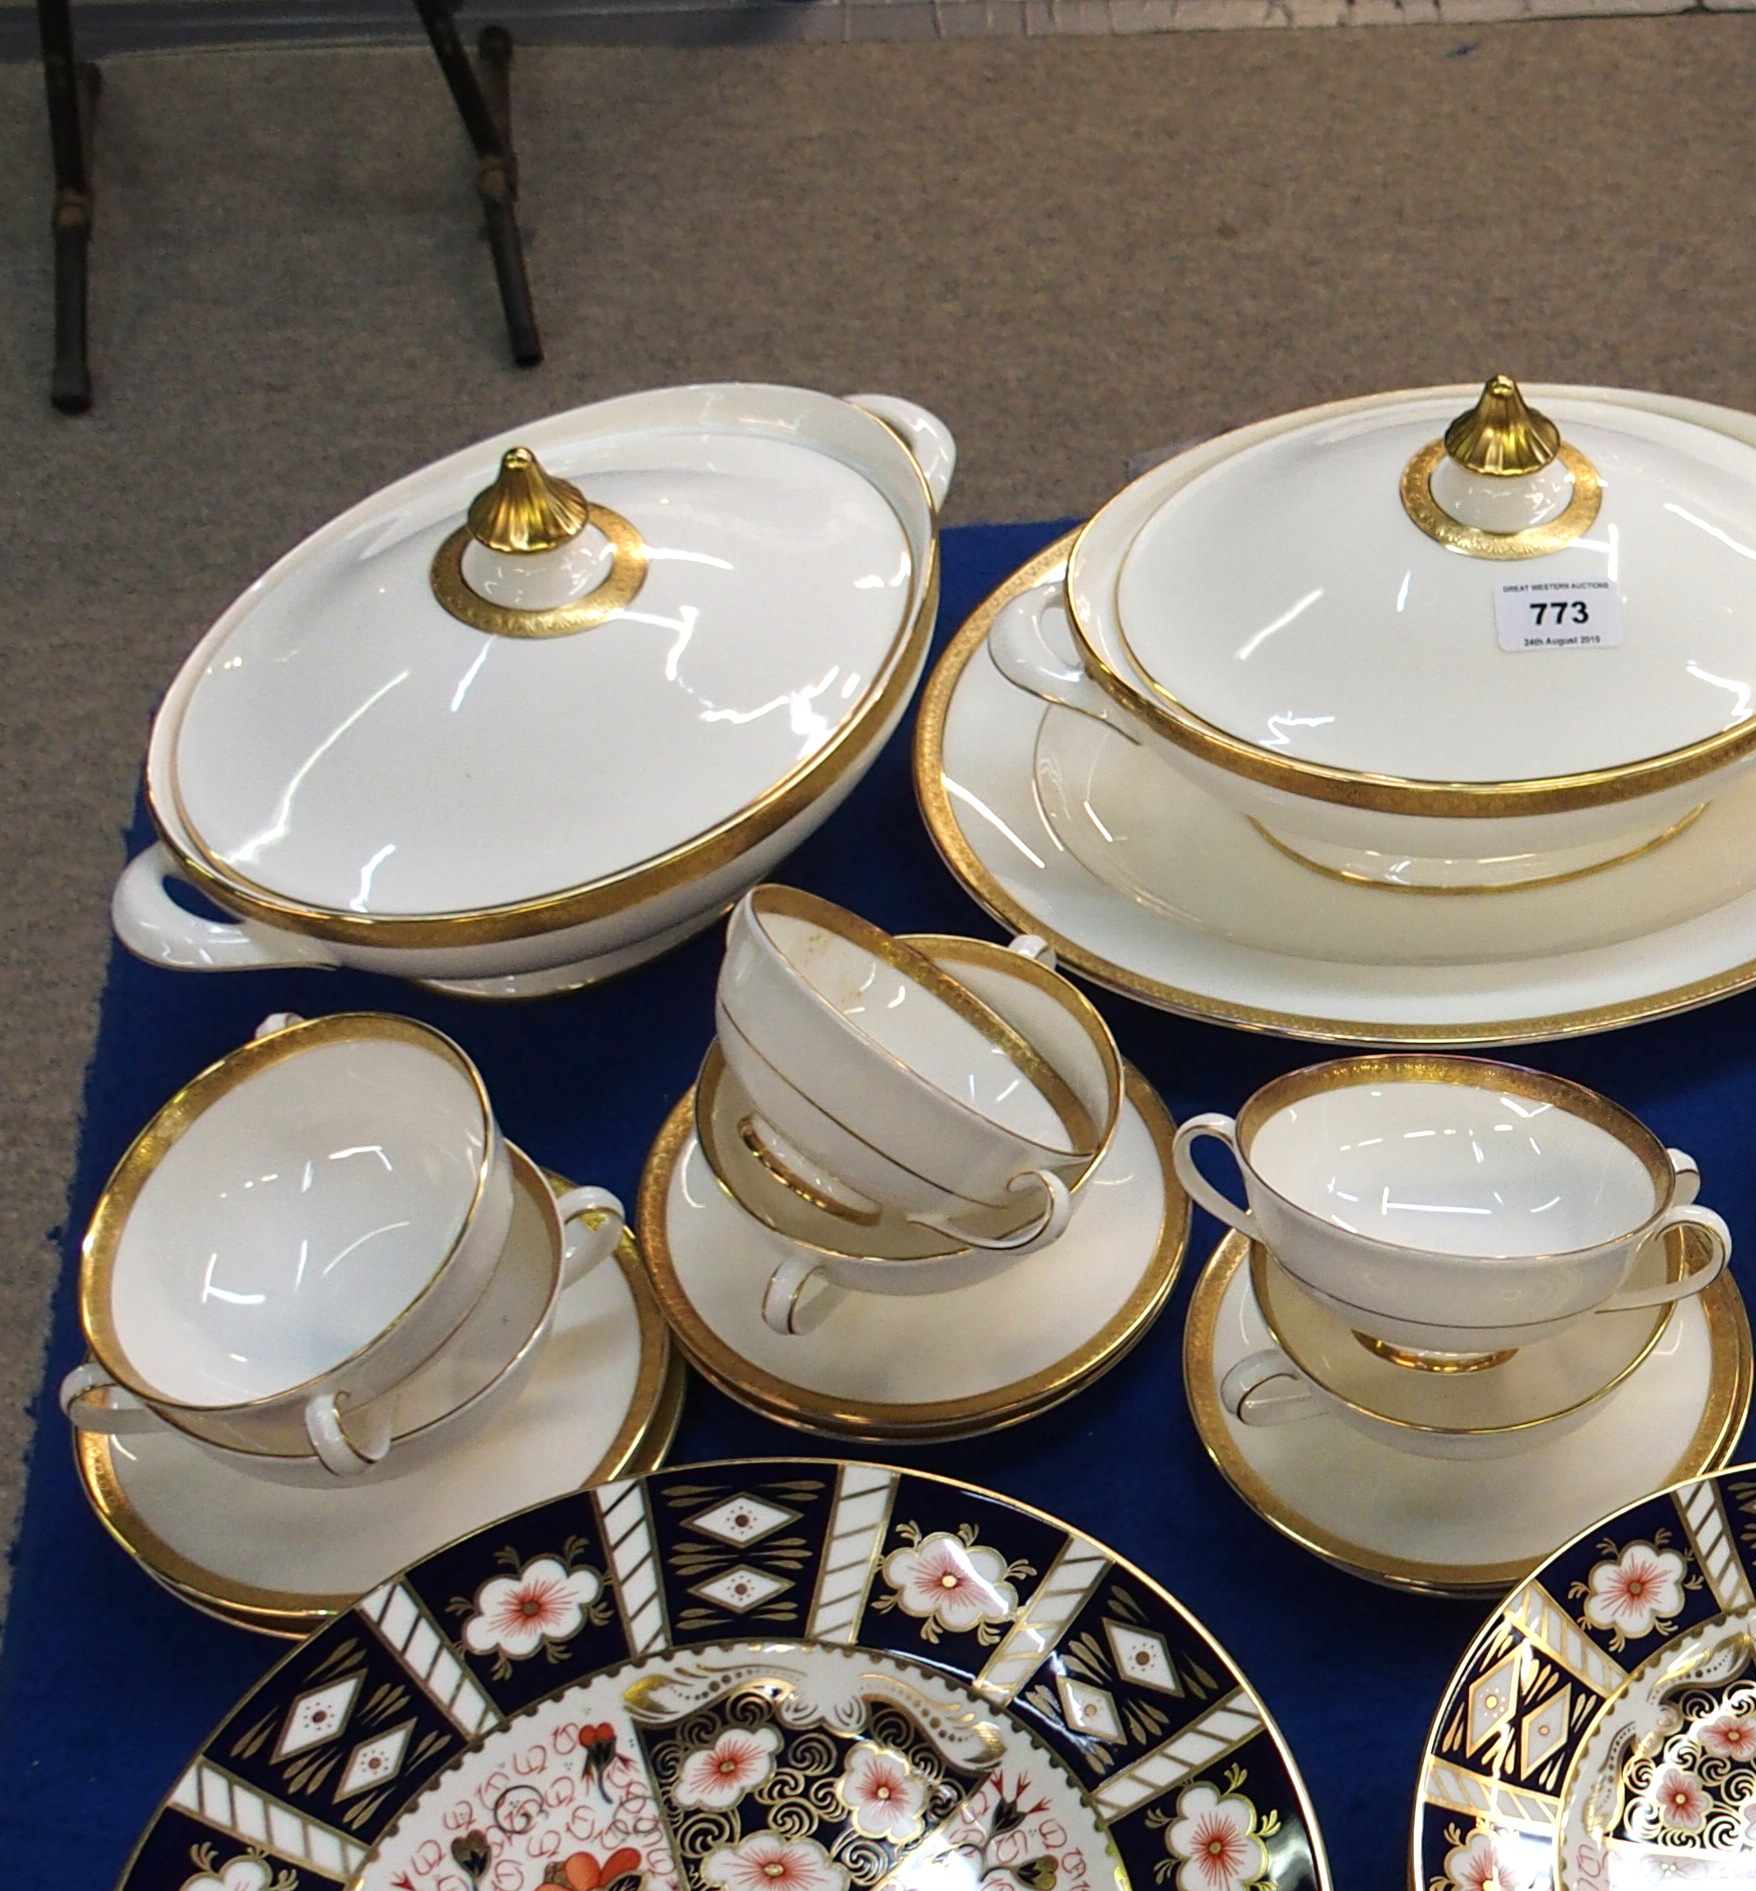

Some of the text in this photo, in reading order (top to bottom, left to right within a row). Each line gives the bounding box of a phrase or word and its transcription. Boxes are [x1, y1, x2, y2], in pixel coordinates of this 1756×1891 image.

[1502, 584, 1529, 593] GREAT
[1531, 583, 1569, 591] WESTERN
[1529, 601, 1589, 625] 773
[1524, 638, 1544, 647] 24th
[1546, 636, 1578, 646] August
